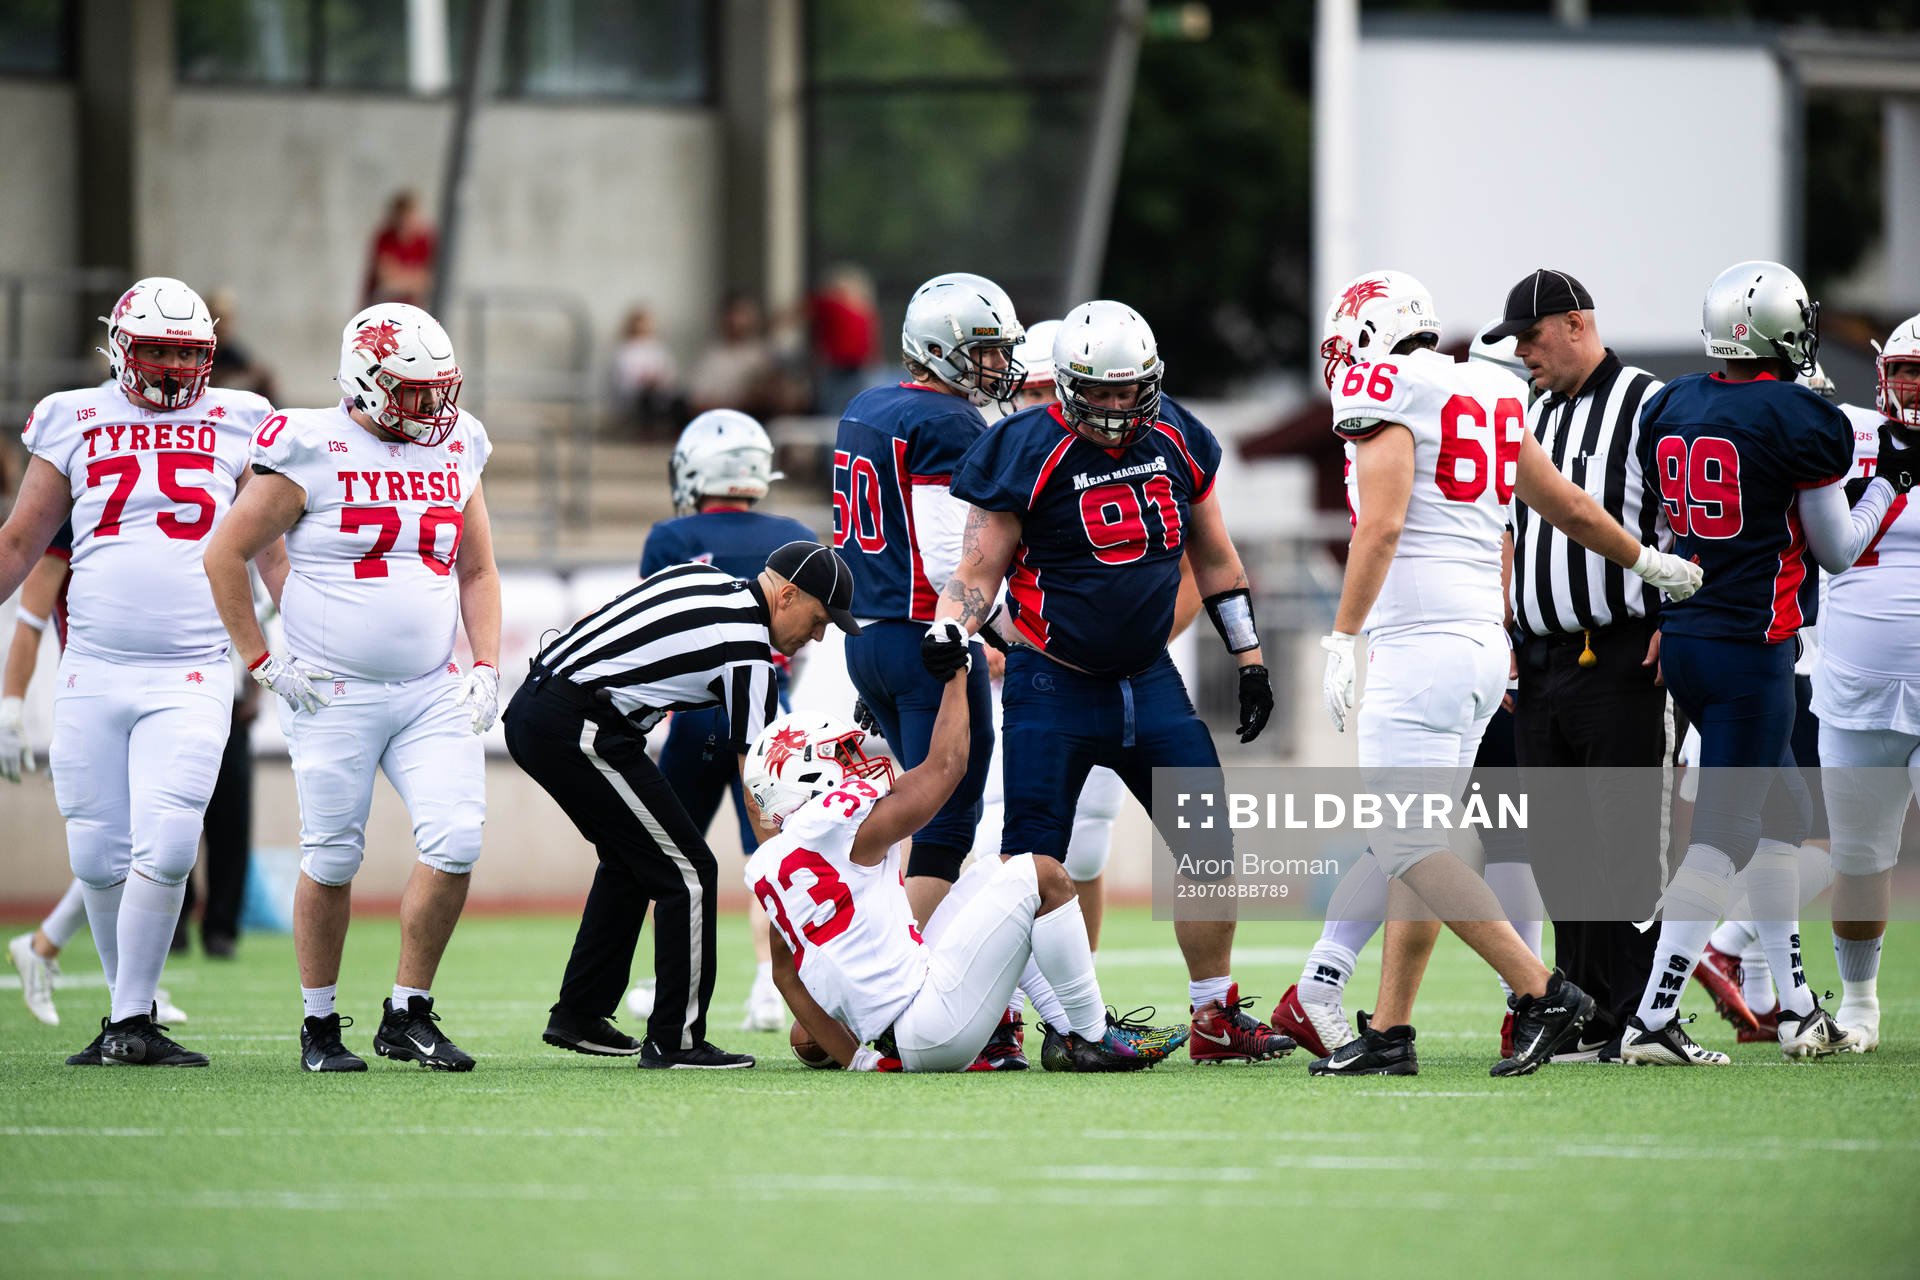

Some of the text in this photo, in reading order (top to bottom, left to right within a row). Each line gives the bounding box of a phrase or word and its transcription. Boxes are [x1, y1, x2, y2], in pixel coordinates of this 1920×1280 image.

[166, 328, 193, 337] Riddell
[974, 327, 997, 336] PMA
[1107, 370, 1135, 379] Riddell
[1341, 362, 1399, 402] 66
[76, 408, 97, 422] 135
[82, 419, 217, 458] TYRESÖ
[327, 440, 349, 454] 135
[1434, 394, 1525, 506] 66
[86, 452, 217, 541] 75
[337, 462, 462, 503] TYRESÖ
[1656, 435, 1744, 540] 99
[1079, 474, 1183, 566] 91
[339, 506, 465, 580] 70
[822, 779, 879, 818] 33
[1543, 1006, 1568, 1014] ALPHA
